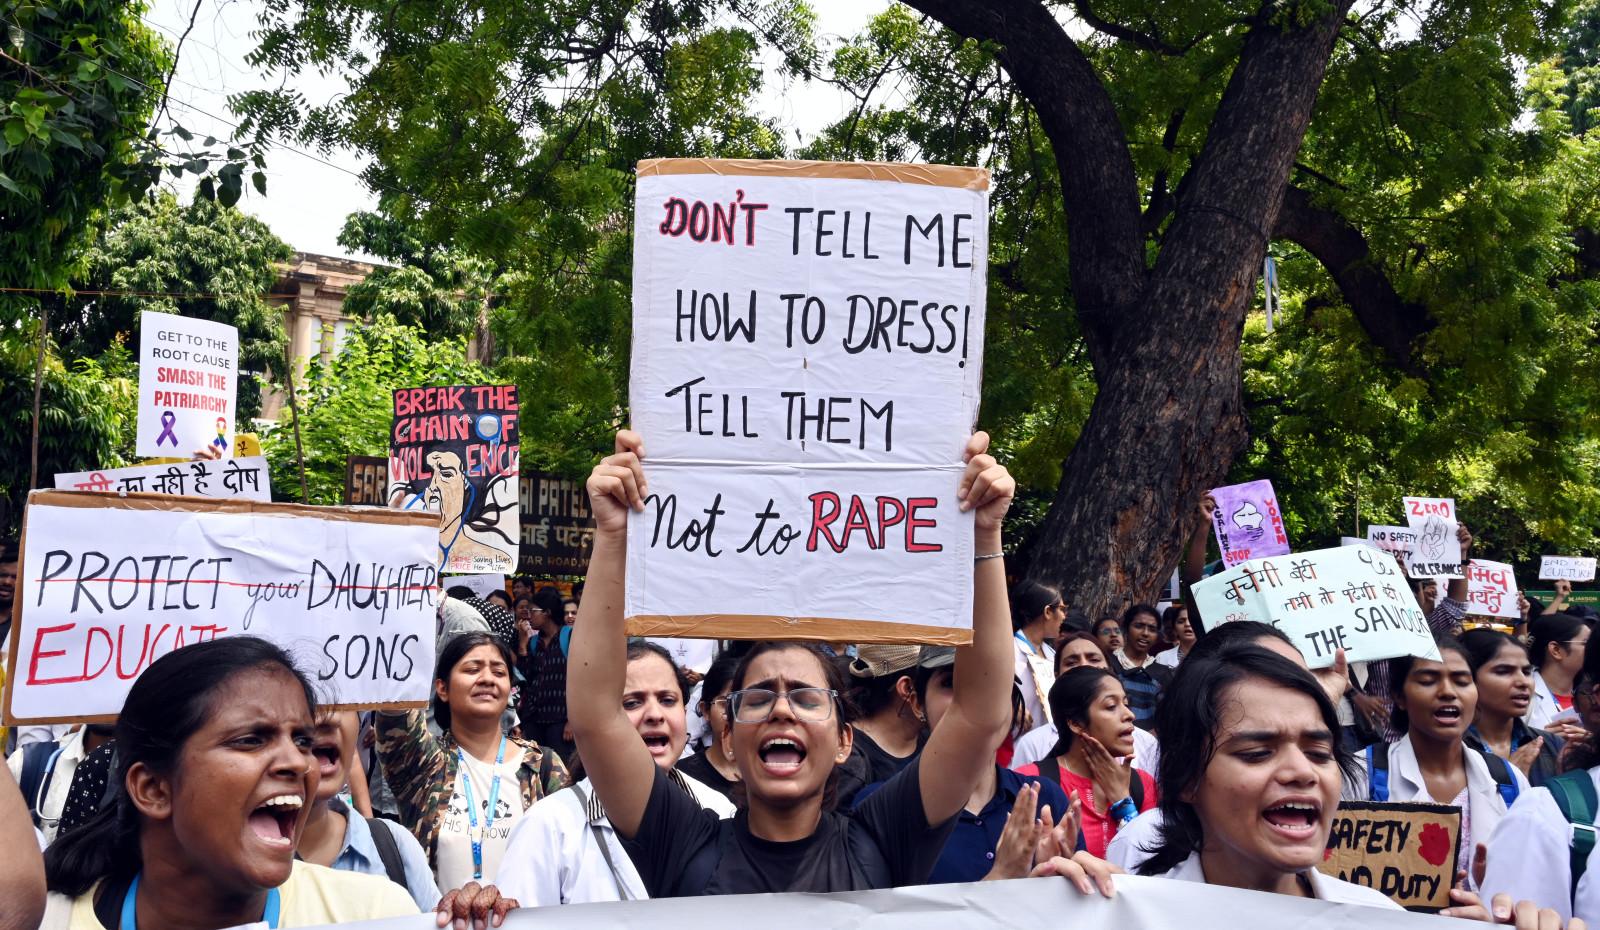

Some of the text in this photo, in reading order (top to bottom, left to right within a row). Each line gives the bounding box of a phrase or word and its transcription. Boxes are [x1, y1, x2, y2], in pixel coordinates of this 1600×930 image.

[659, 188, 973, 268] DON'T TELL ME
[157, 330, 228, 352] GET TO THE
[675, 288, 971, 369] HOW TO DRESS!
[152, 347, 230, 369] ROOT CAUSE
[157, 366, 226, 391] SMASH THE
[154, 390, 228, 414] PATRIARCHY
[395, 385, 519, 416] BREAK THE
[664, 376, 894, 452] TELL THEM
[394, 413, 471, 443] CHAIN
[190, 462, 212, 495] है
[223, 460, 260, 494] दोष
[643, 490, 943, 558] Not to RAPE
[1408, 501, 1450, 518] ZERO
[1372, 531, 1418, 543] NO SAFETY
[1225, 549, 1251, 562] STOP
[37, 549, 233, 615] PROTECT
[243, 580, 305, 630] your
[1304, 604, 1430, 657] THE SAVIOUR
[318, 633, 419, 682] SONS
[442, 818, 461, 833] HIS
[1379, 866, 1441, 901] DUTY
